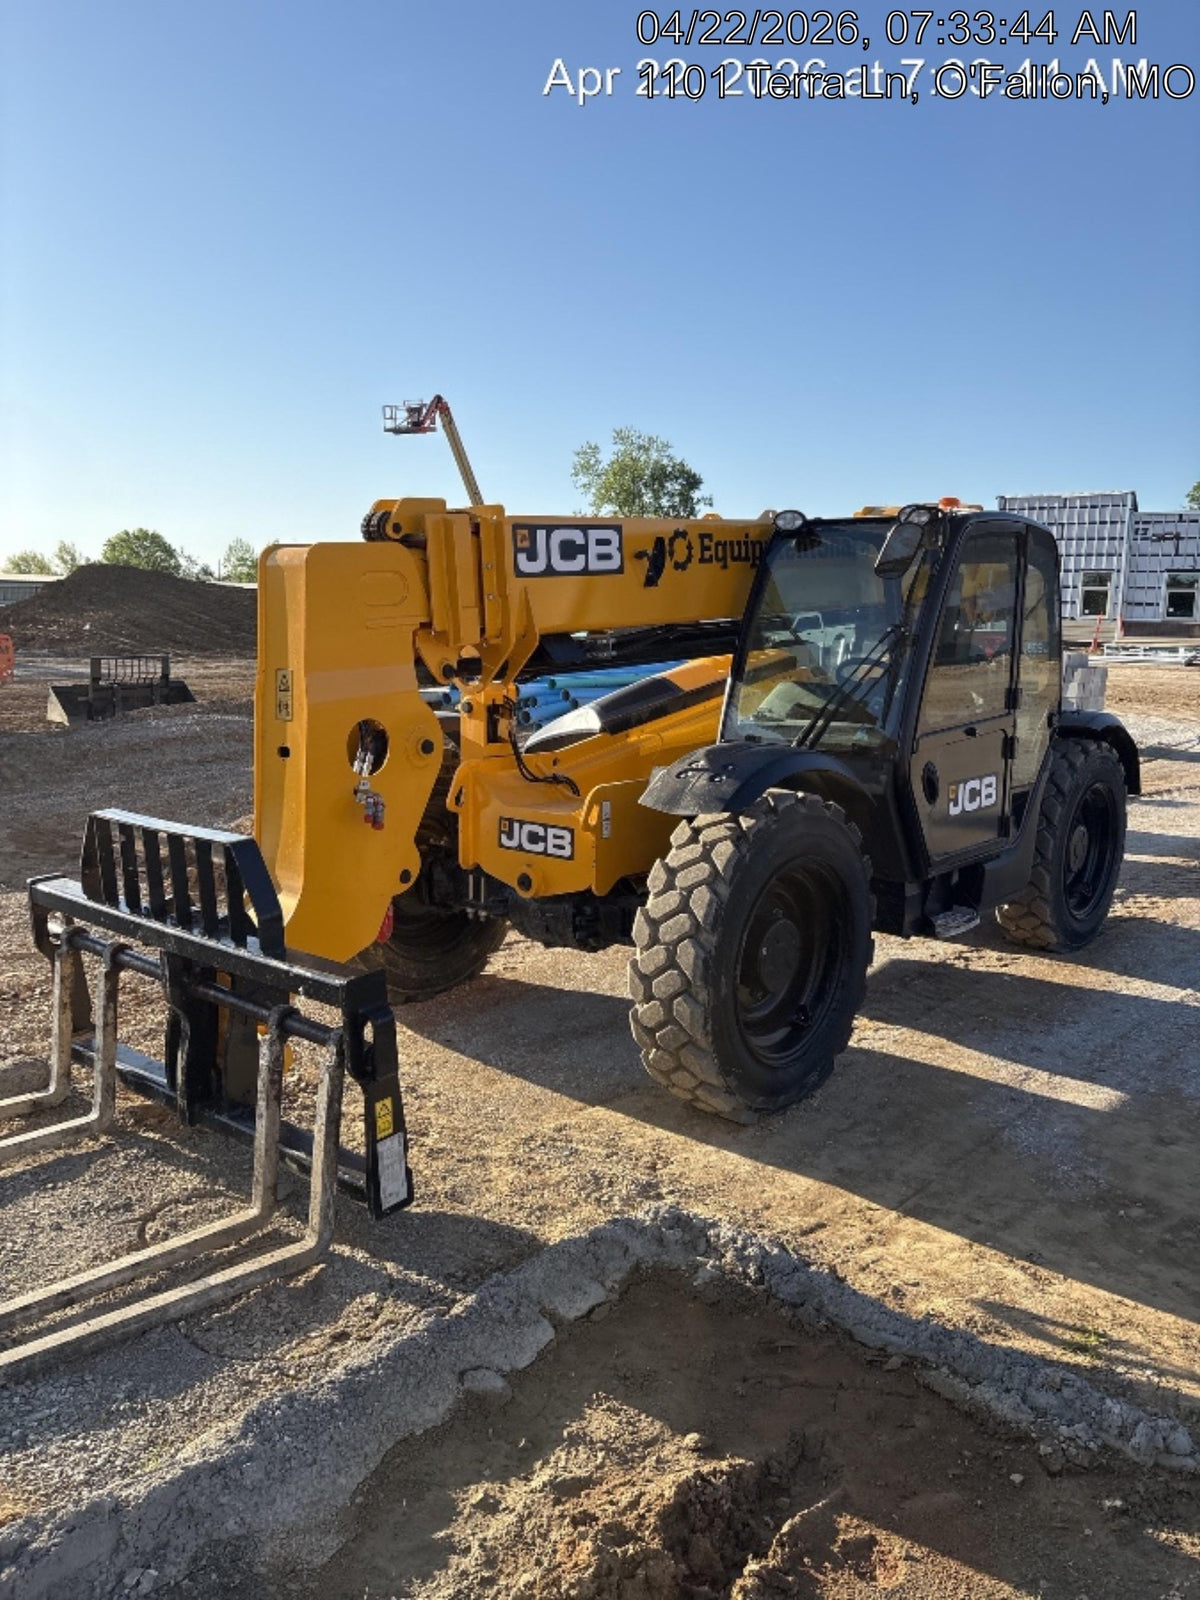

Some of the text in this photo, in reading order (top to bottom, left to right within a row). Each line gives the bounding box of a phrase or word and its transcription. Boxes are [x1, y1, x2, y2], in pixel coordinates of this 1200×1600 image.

[516, 528, 622, 574] JCB
[698, 533, 767, 569] Equip
[948, 775, 997, 816] JCB
[500, 821, 572, 858] JCB
